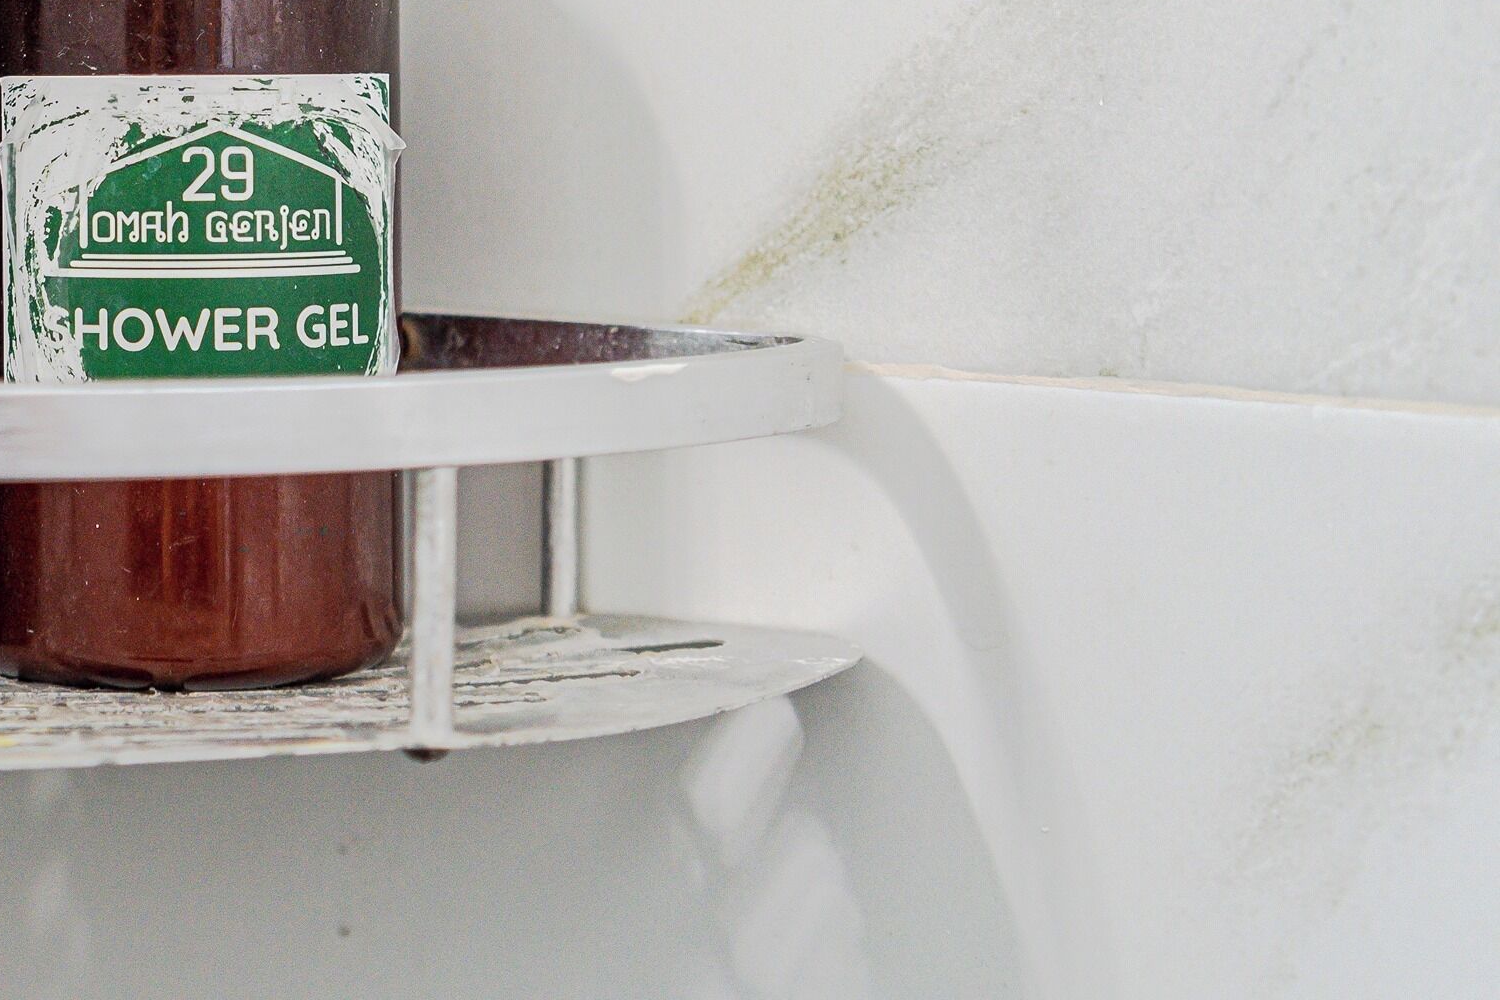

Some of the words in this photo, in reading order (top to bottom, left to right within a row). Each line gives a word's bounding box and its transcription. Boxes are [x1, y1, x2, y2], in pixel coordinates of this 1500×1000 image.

[182, 146, 254, 201] 29
[44, 307, 280, 352] SHOWER
[296, 302, 369, 349] GEL
